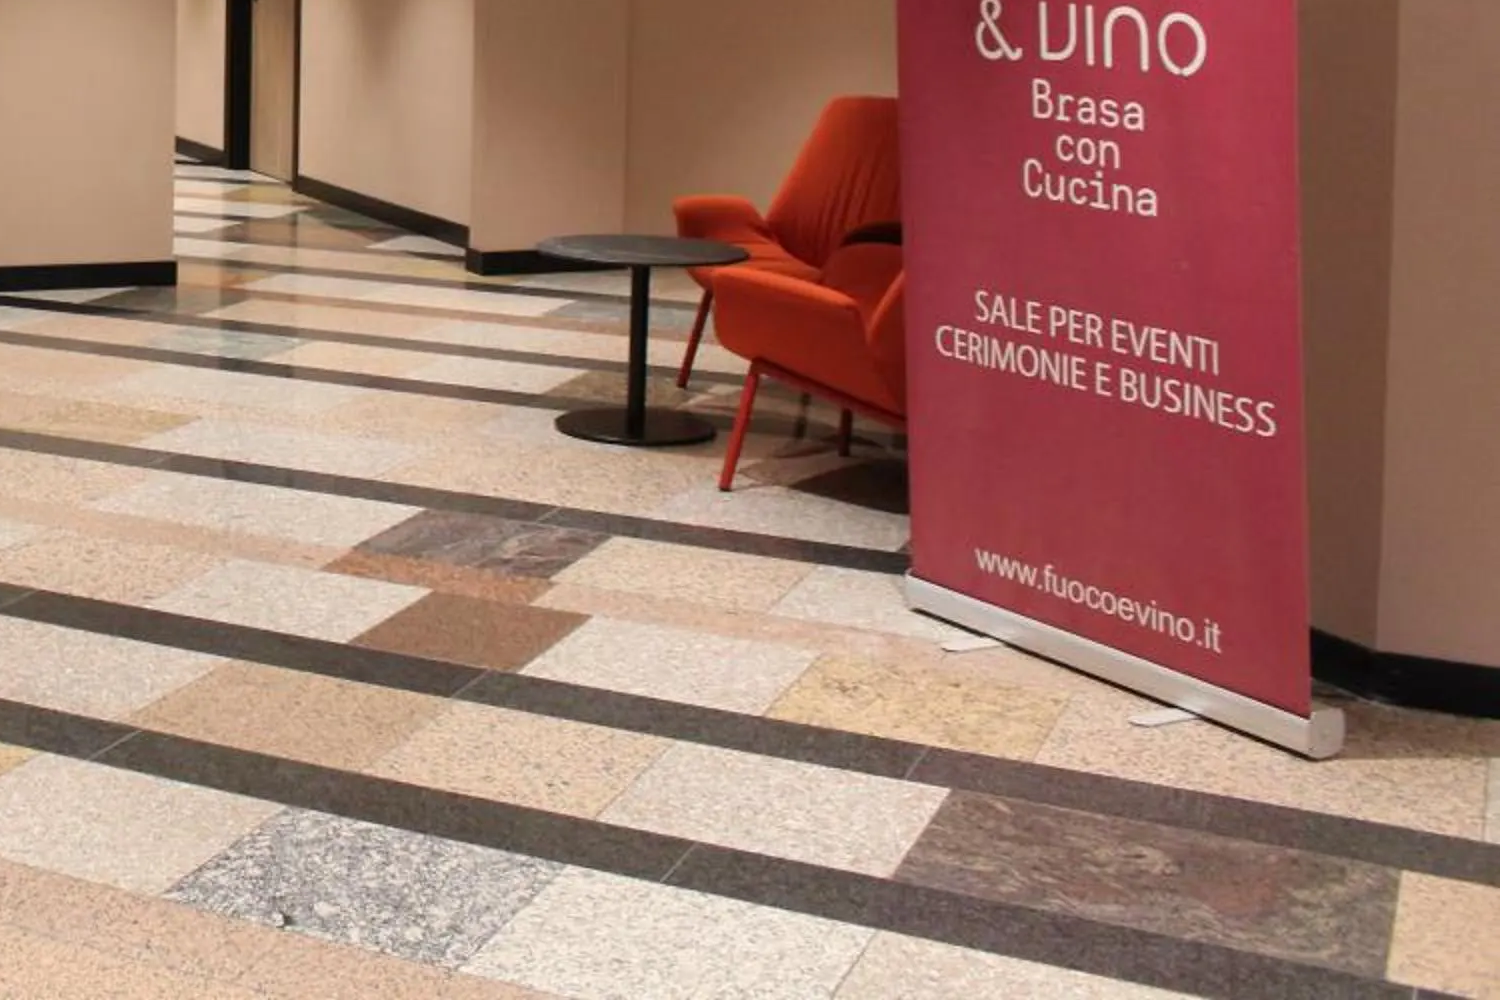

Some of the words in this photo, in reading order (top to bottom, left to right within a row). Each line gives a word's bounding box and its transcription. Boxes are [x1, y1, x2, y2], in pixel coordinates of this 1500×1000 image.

[1031, 77, 1146, 132] Brasa
[1022, 157, 1159, 217] Cucina
[1056, 133, 1121, 169] con
[974, 289, 1043, 336] SALE
[1049, 305, 1104, 349] PER
[1111, 318, 1220, 377] EVENTI
[934, 325, 1088, 392] CERIMONIE
[1095, 361, 1113, 398] E
[1120, 367, 1278, 438] BUSINESS
[975, 547, 1222, 654] www.fuocoevino.it
